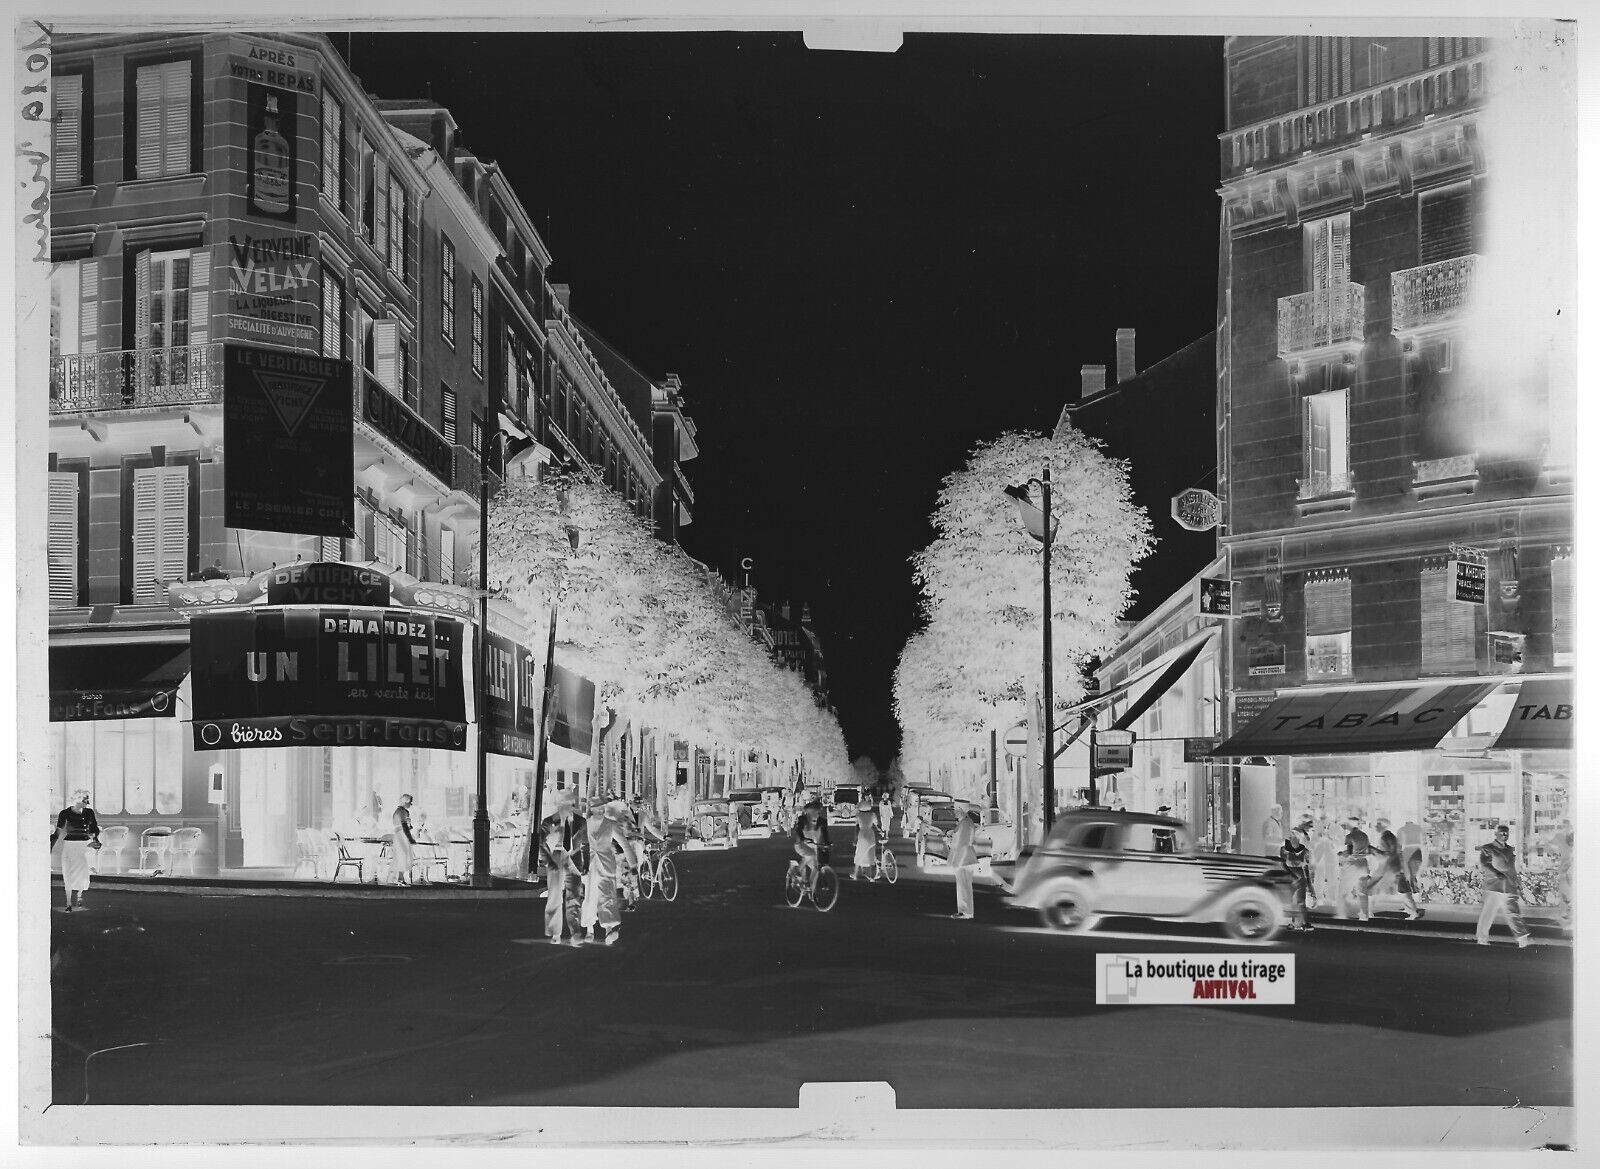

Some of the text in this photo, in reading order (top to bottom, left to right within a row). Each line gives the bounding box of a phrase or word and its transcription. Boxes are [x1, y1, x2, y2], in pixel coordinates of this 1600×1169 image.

[268, 69, 314, 92] REPAS
[230, 234, 312, 268] VERVEINE
[231, 257, 313, 293] VELAY
[237, 299, 250, 310] LA
[238, 349, 252, 365] LE
[275, 566, 382, 587] DENTIFRICE
[295, 586, 374, 603] VICHY
[246, 641, 449, 688] UN LILET
[348, 688, 369, 699] en
[375, 687, 409, 700] vente
[1271, 707, 1446, 731] TABAC
[230, 722, 283, 744] bières
